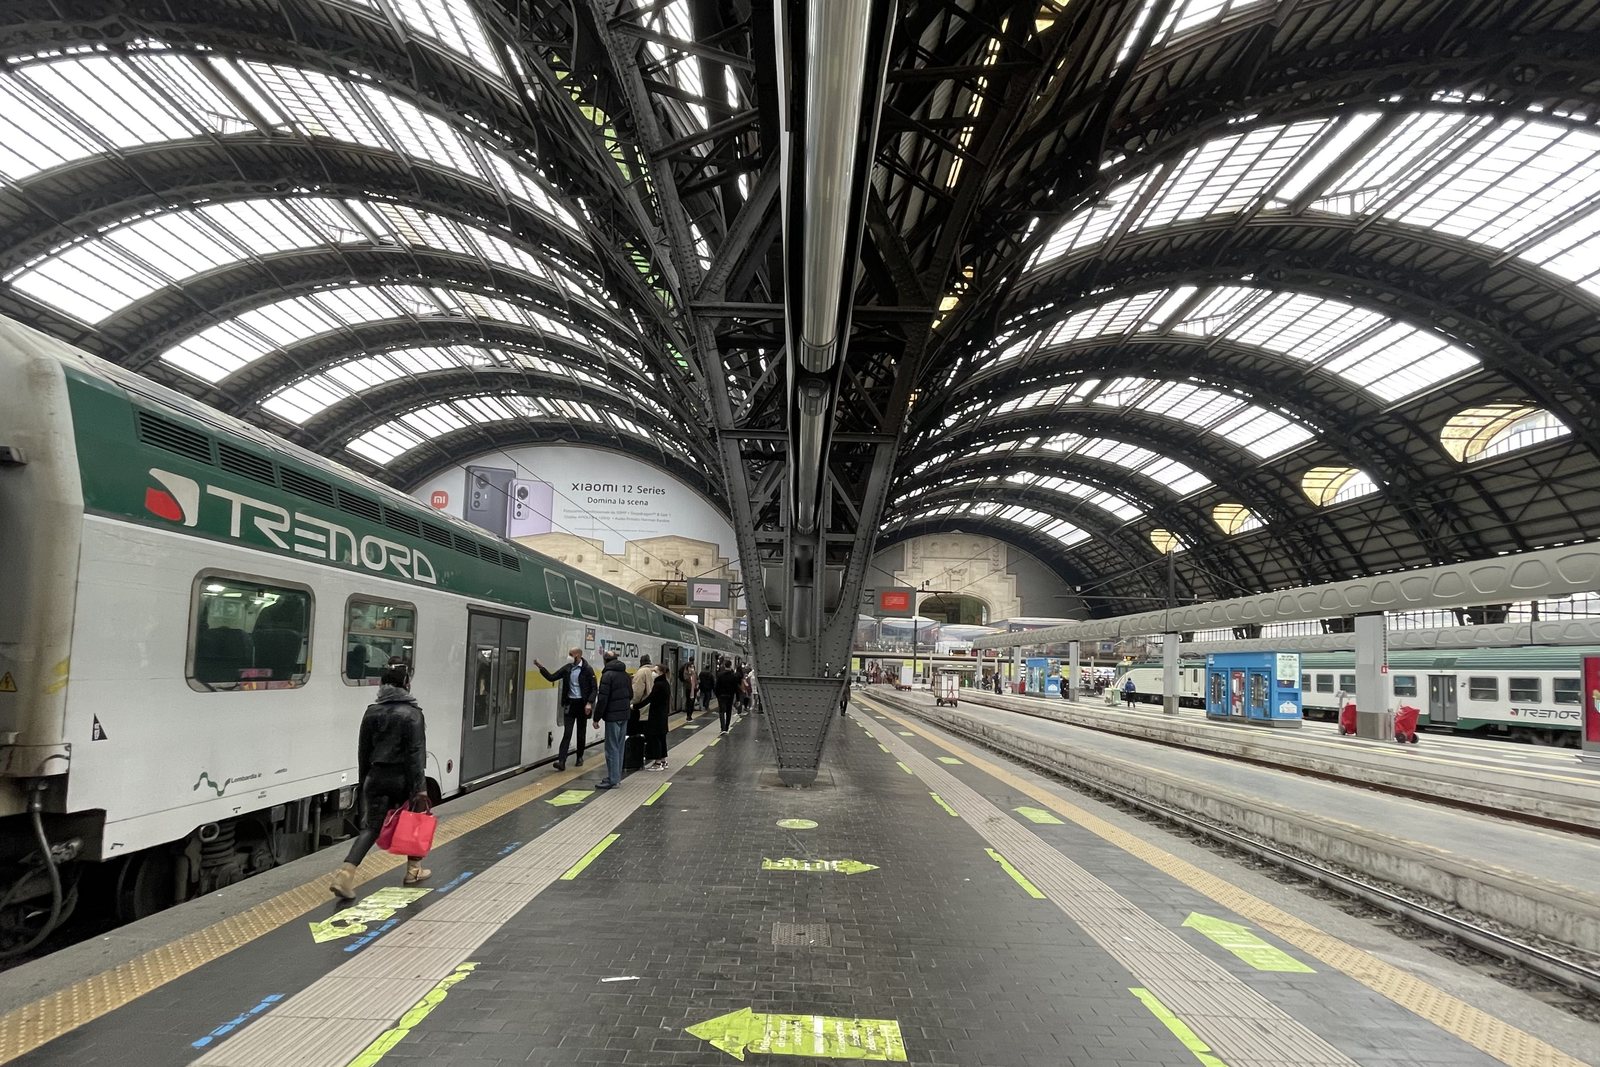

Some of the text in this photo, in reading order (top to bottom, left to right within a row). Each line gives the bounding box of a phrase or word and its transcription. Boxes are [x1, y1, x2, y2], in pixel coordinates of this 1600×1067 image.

[622, 485, 633, 494] 12
[637, 485, 666, 495] Series
[587, 496, 617, 505] Domina
[618, 497, 626, 505] la
[206, 484, 437, 585] TRENORD
[1520, 708, 1581, 720] TRENOR
